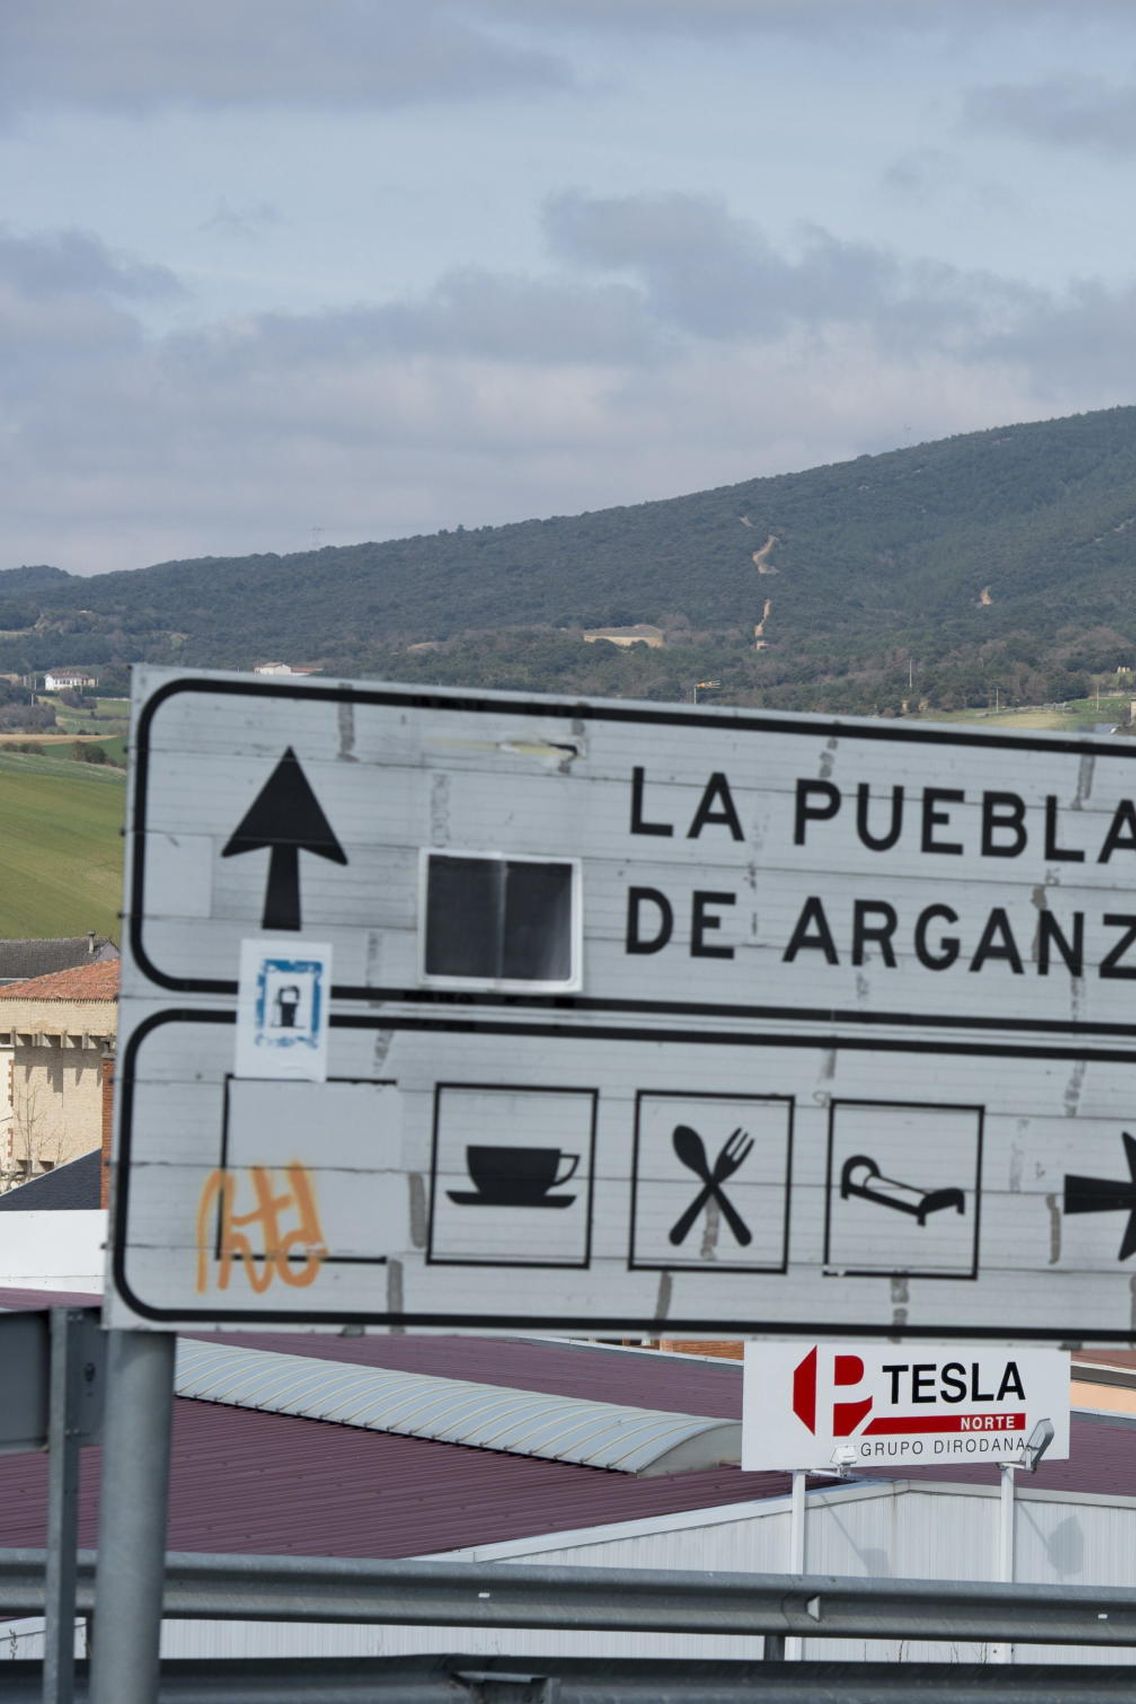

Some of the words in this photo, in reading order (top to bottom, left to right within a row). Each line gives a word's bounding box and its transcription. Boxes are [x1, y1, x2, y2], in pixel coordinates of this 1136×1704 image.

[629, 766, 745, 842] LA
[625, 885, 737, 959] DE
[882, 1361, 1026, 1404] TESLA
[960, 1416, 1015, 1431] NORTE
[860, 1441, 924, 1456] GRUPO
[933, 1437, 1026, 1454] DIRODANA
